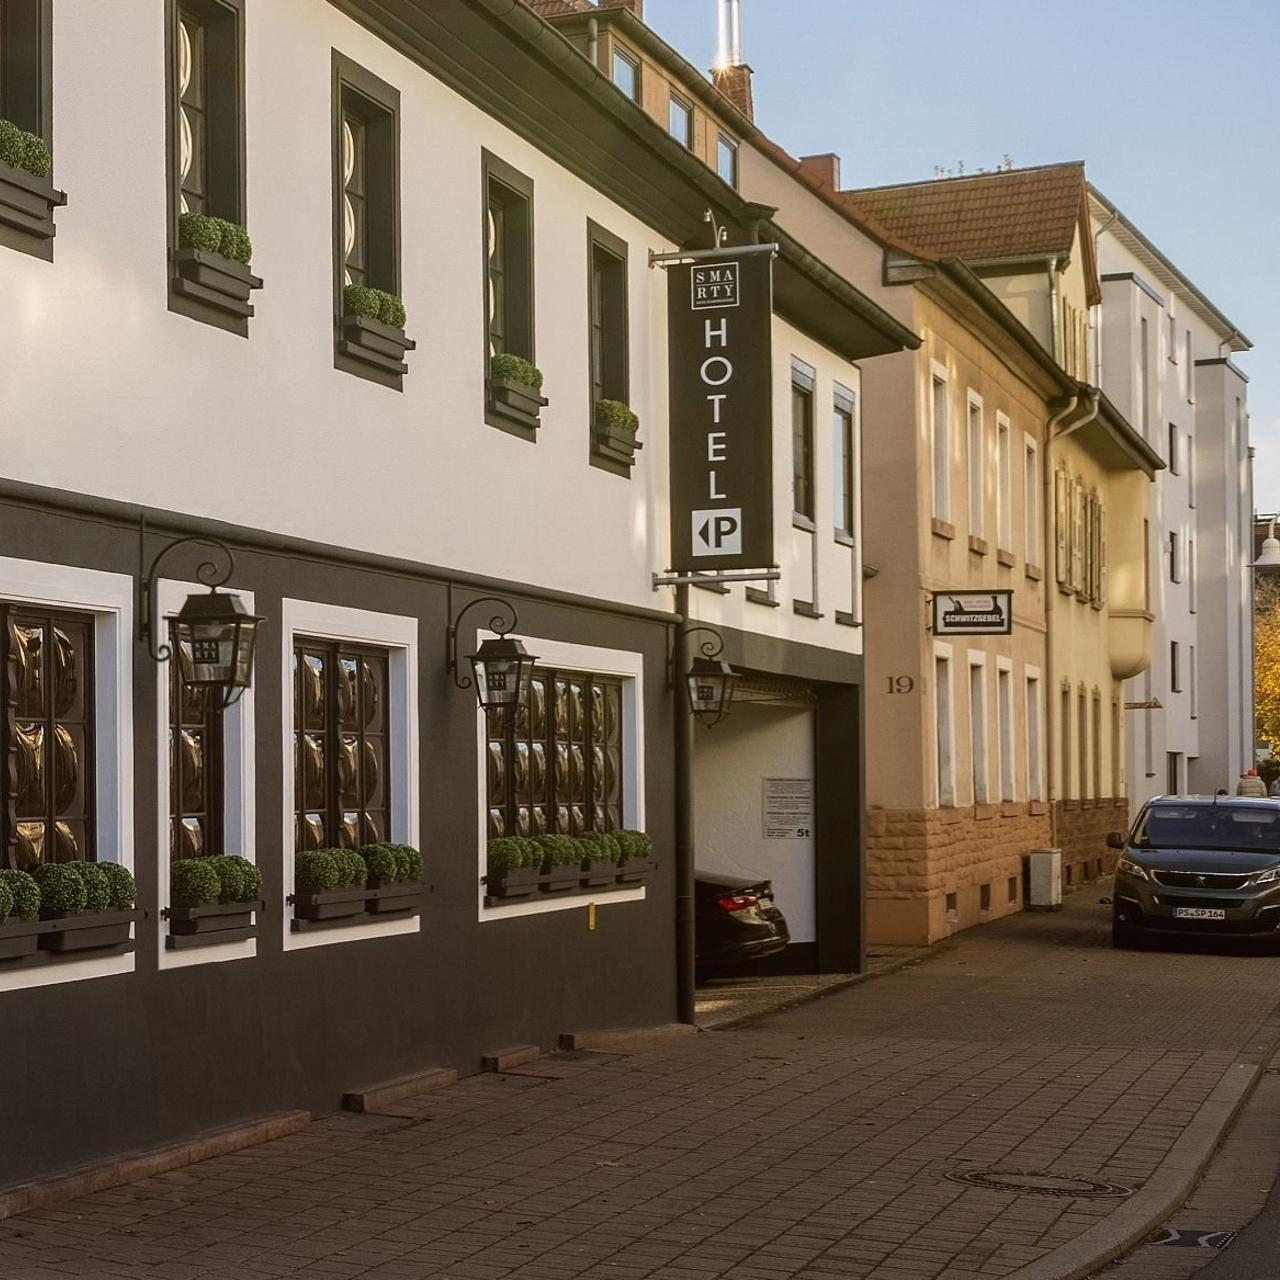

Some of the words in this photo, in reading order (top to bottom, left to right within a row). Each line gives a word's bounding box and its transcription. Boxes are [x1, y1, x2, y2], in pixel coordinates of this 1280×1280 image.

[696, 269, 734, 283] SMA
[697, 284, 734, 299] RTY
[700, 318, 733, 500] HOTEL
[714, 515, 738, 548] P
[886, 675, 914, 694] 19
